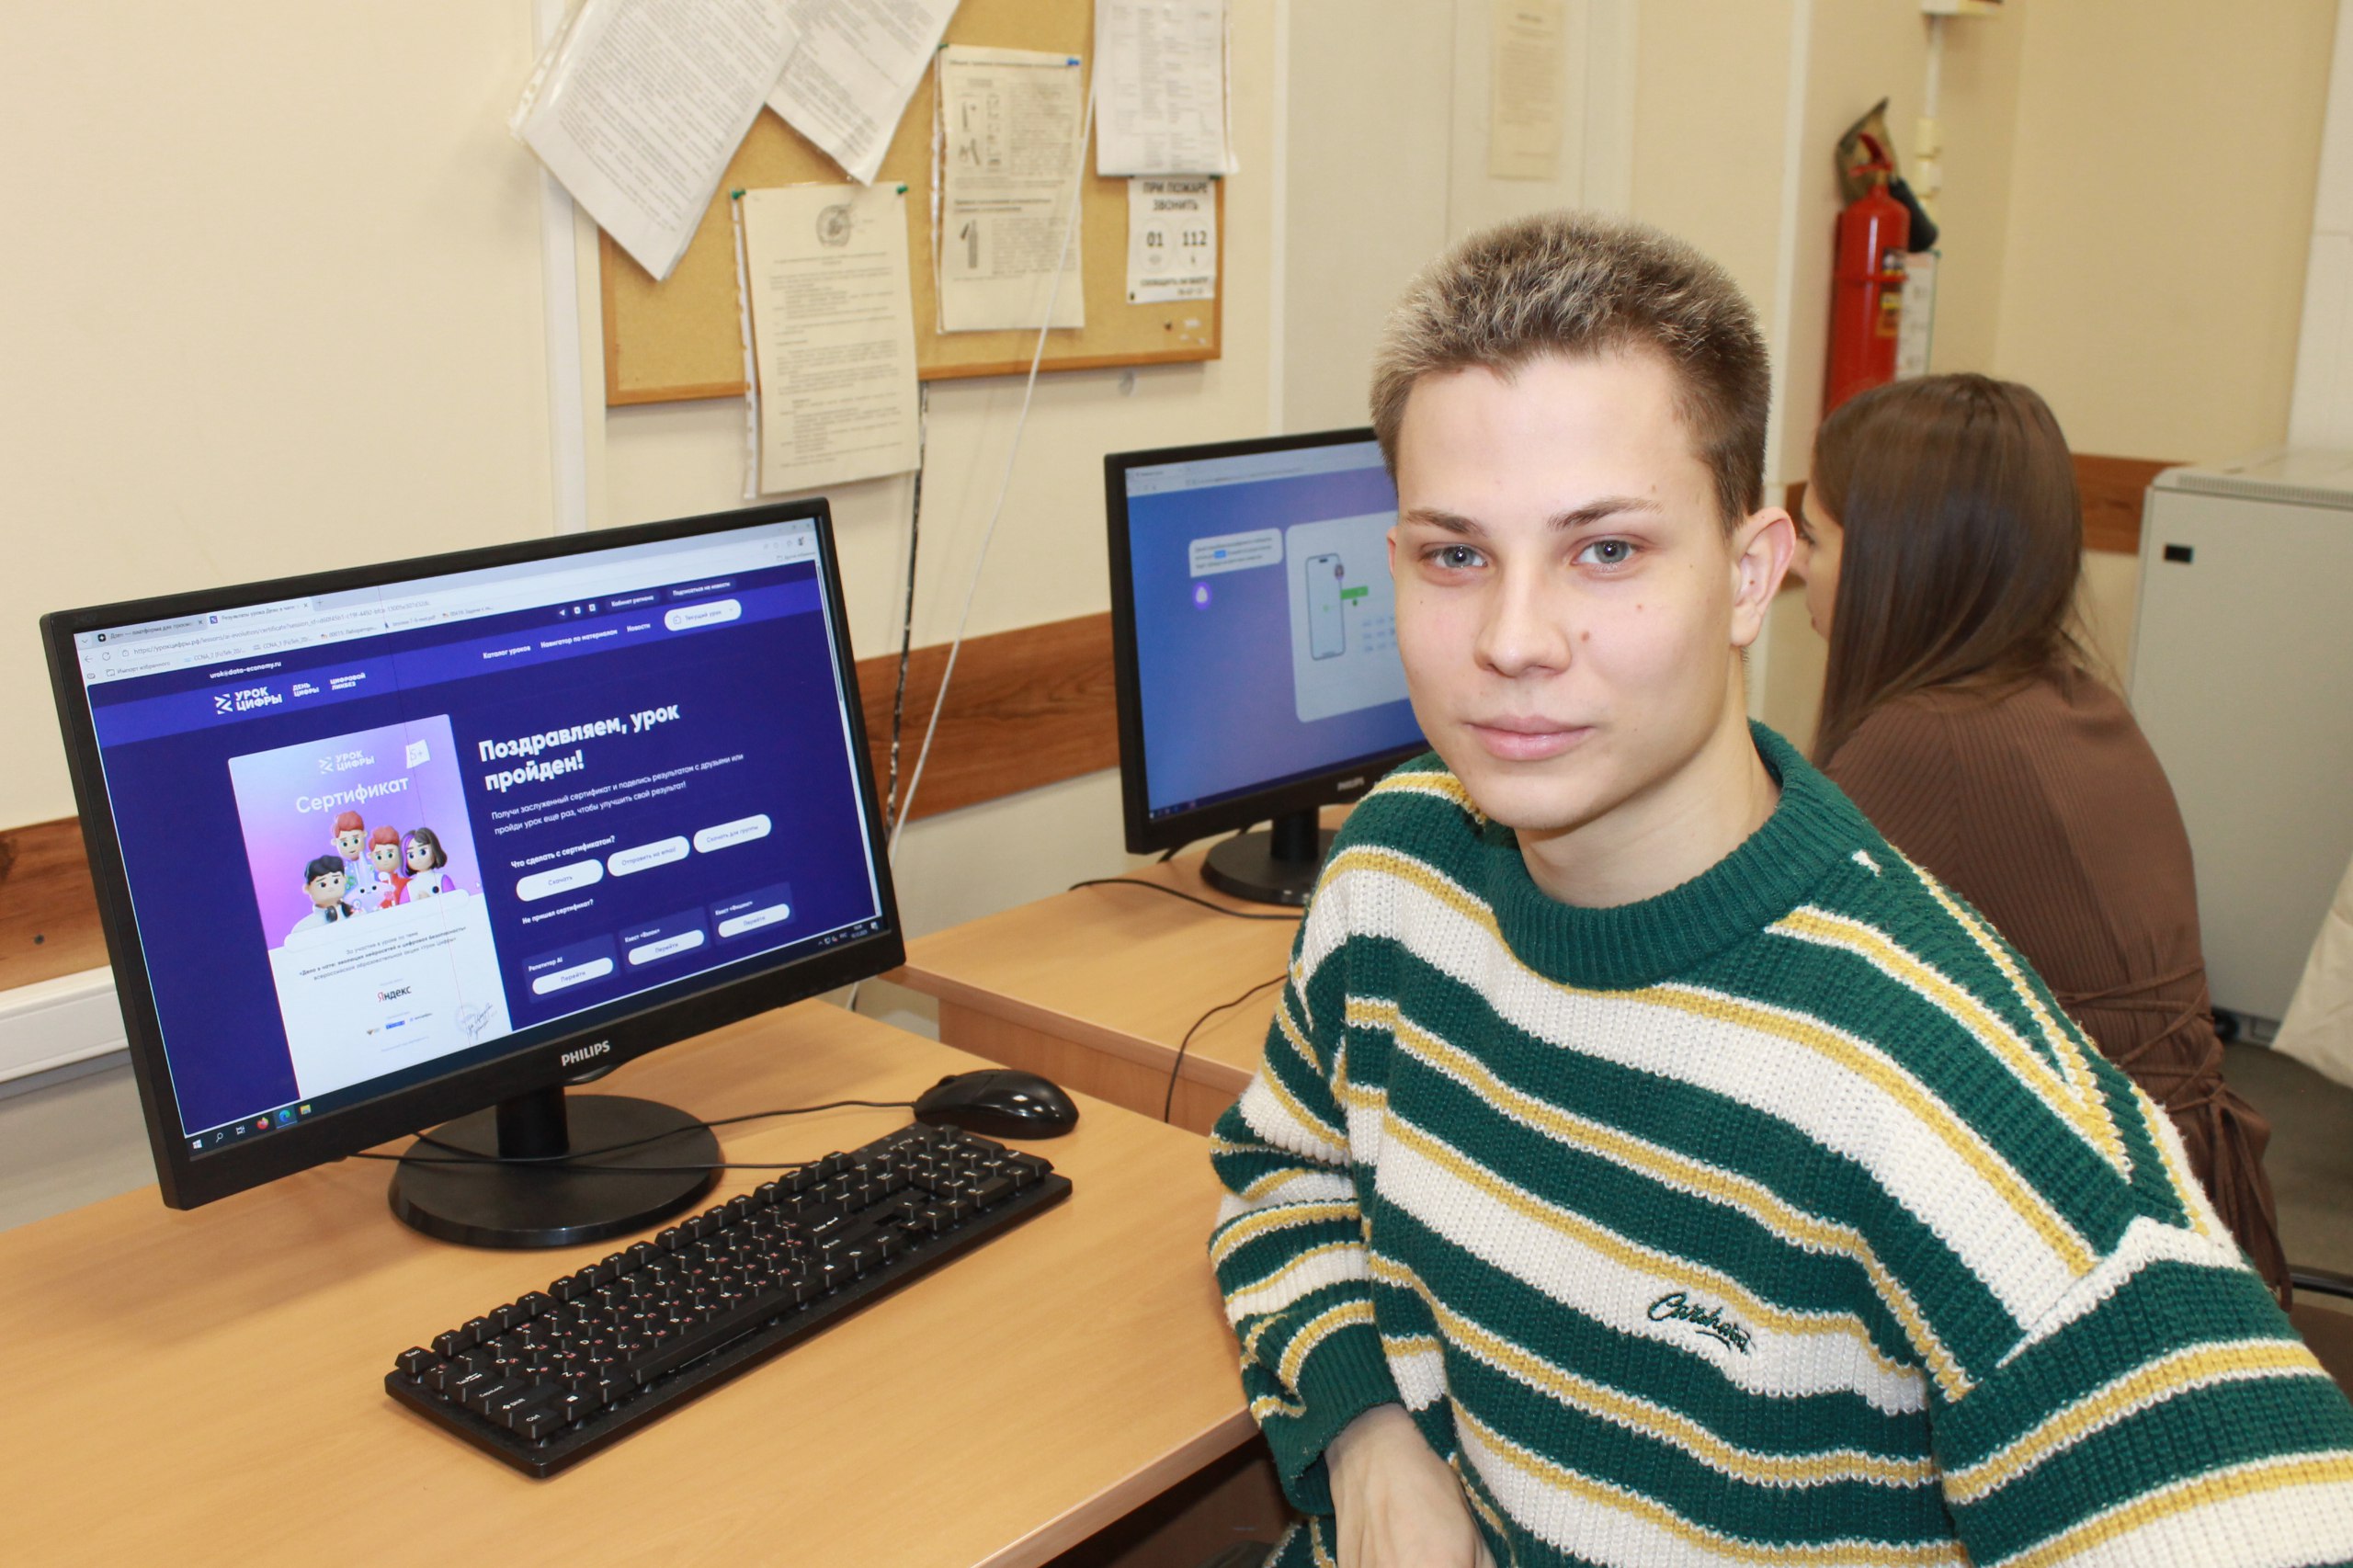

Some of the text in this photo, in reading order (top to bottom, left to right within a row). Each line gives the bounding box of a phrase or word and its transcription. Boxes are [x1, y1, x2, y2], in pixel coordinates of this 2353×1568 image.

[1142, 181, 1208, 194] ПРИ ПОЖАРЕ
[1153, 199, 1199, 211] ЗВОНИТЬ
[1146, 231, 1164, 247] 01
[1182, 231, 1208, 246] 112
[626, 623, 651, 632] Новости
[540, 637, 573, 649] Навигатор
[581, 629, 618, 641] материалам
[483, 645, 531, 659] Каталог уроков
[210, 661, 281, 678] urok@data-economy.ru
[329, 672, 367, 686] ЦИФРОВОЙ
[331, 681, 357, 690] ЛИКБЕЗ
[234, 687, 268, 701] УРОК
[292, 683, 311, 691] ДЕНЬ
[293, 687, 320, 697] ЦИФРЫ
[235, 694, 283, 711] ЦИФРЫ
[478, 704, 680, 762] Поздравляем, урок
[336, 750, 363, 762] УРОК
[336, 755, 375, 772] ЦИФРЫ
[484, 749, 585, 792] пройден!
[492, 807, 519, 821] Получи
[520, 795, 569, 813] заслуженный
[570, 785, 611, 802] сертификат
[619, 776, 652, 790] поделись
[653, 766, 694, 782] результатом
[700, 756, 731, 770] друзьями
[732, 753, 744, 761] или
[296, 777, 409, 813] Сертификат
[494, 780, 687, 836] пройди урок еще раз, чтобы улучшить свой результат!
[706, 832, 729, 844] Скачать
[510, 859, 525, 869] Что
[526, 852, 555, 867] сделать
[562, 835, 616, 857] сертификатом?
[621, 852, 652, 867] Отправить
[661, 846, 676, 855] email
[548, 875, 573, 887] Скачать
[522, 898, 594, 925] Не пришел сертификат?
[743, 915, 766, 927] Перейти
[624, 935, 640, 943] Квест
[655, 942, 678, 954] Перейти
[529, 959, 555, 972] Репетитор
[561, 971, 585, 983] Перейти
[377, 985, 412, 1003] Яндекс
[561, 1040, 610, 1066] PHILIPS
[526, 1414, 541, 1422] Ctrl
